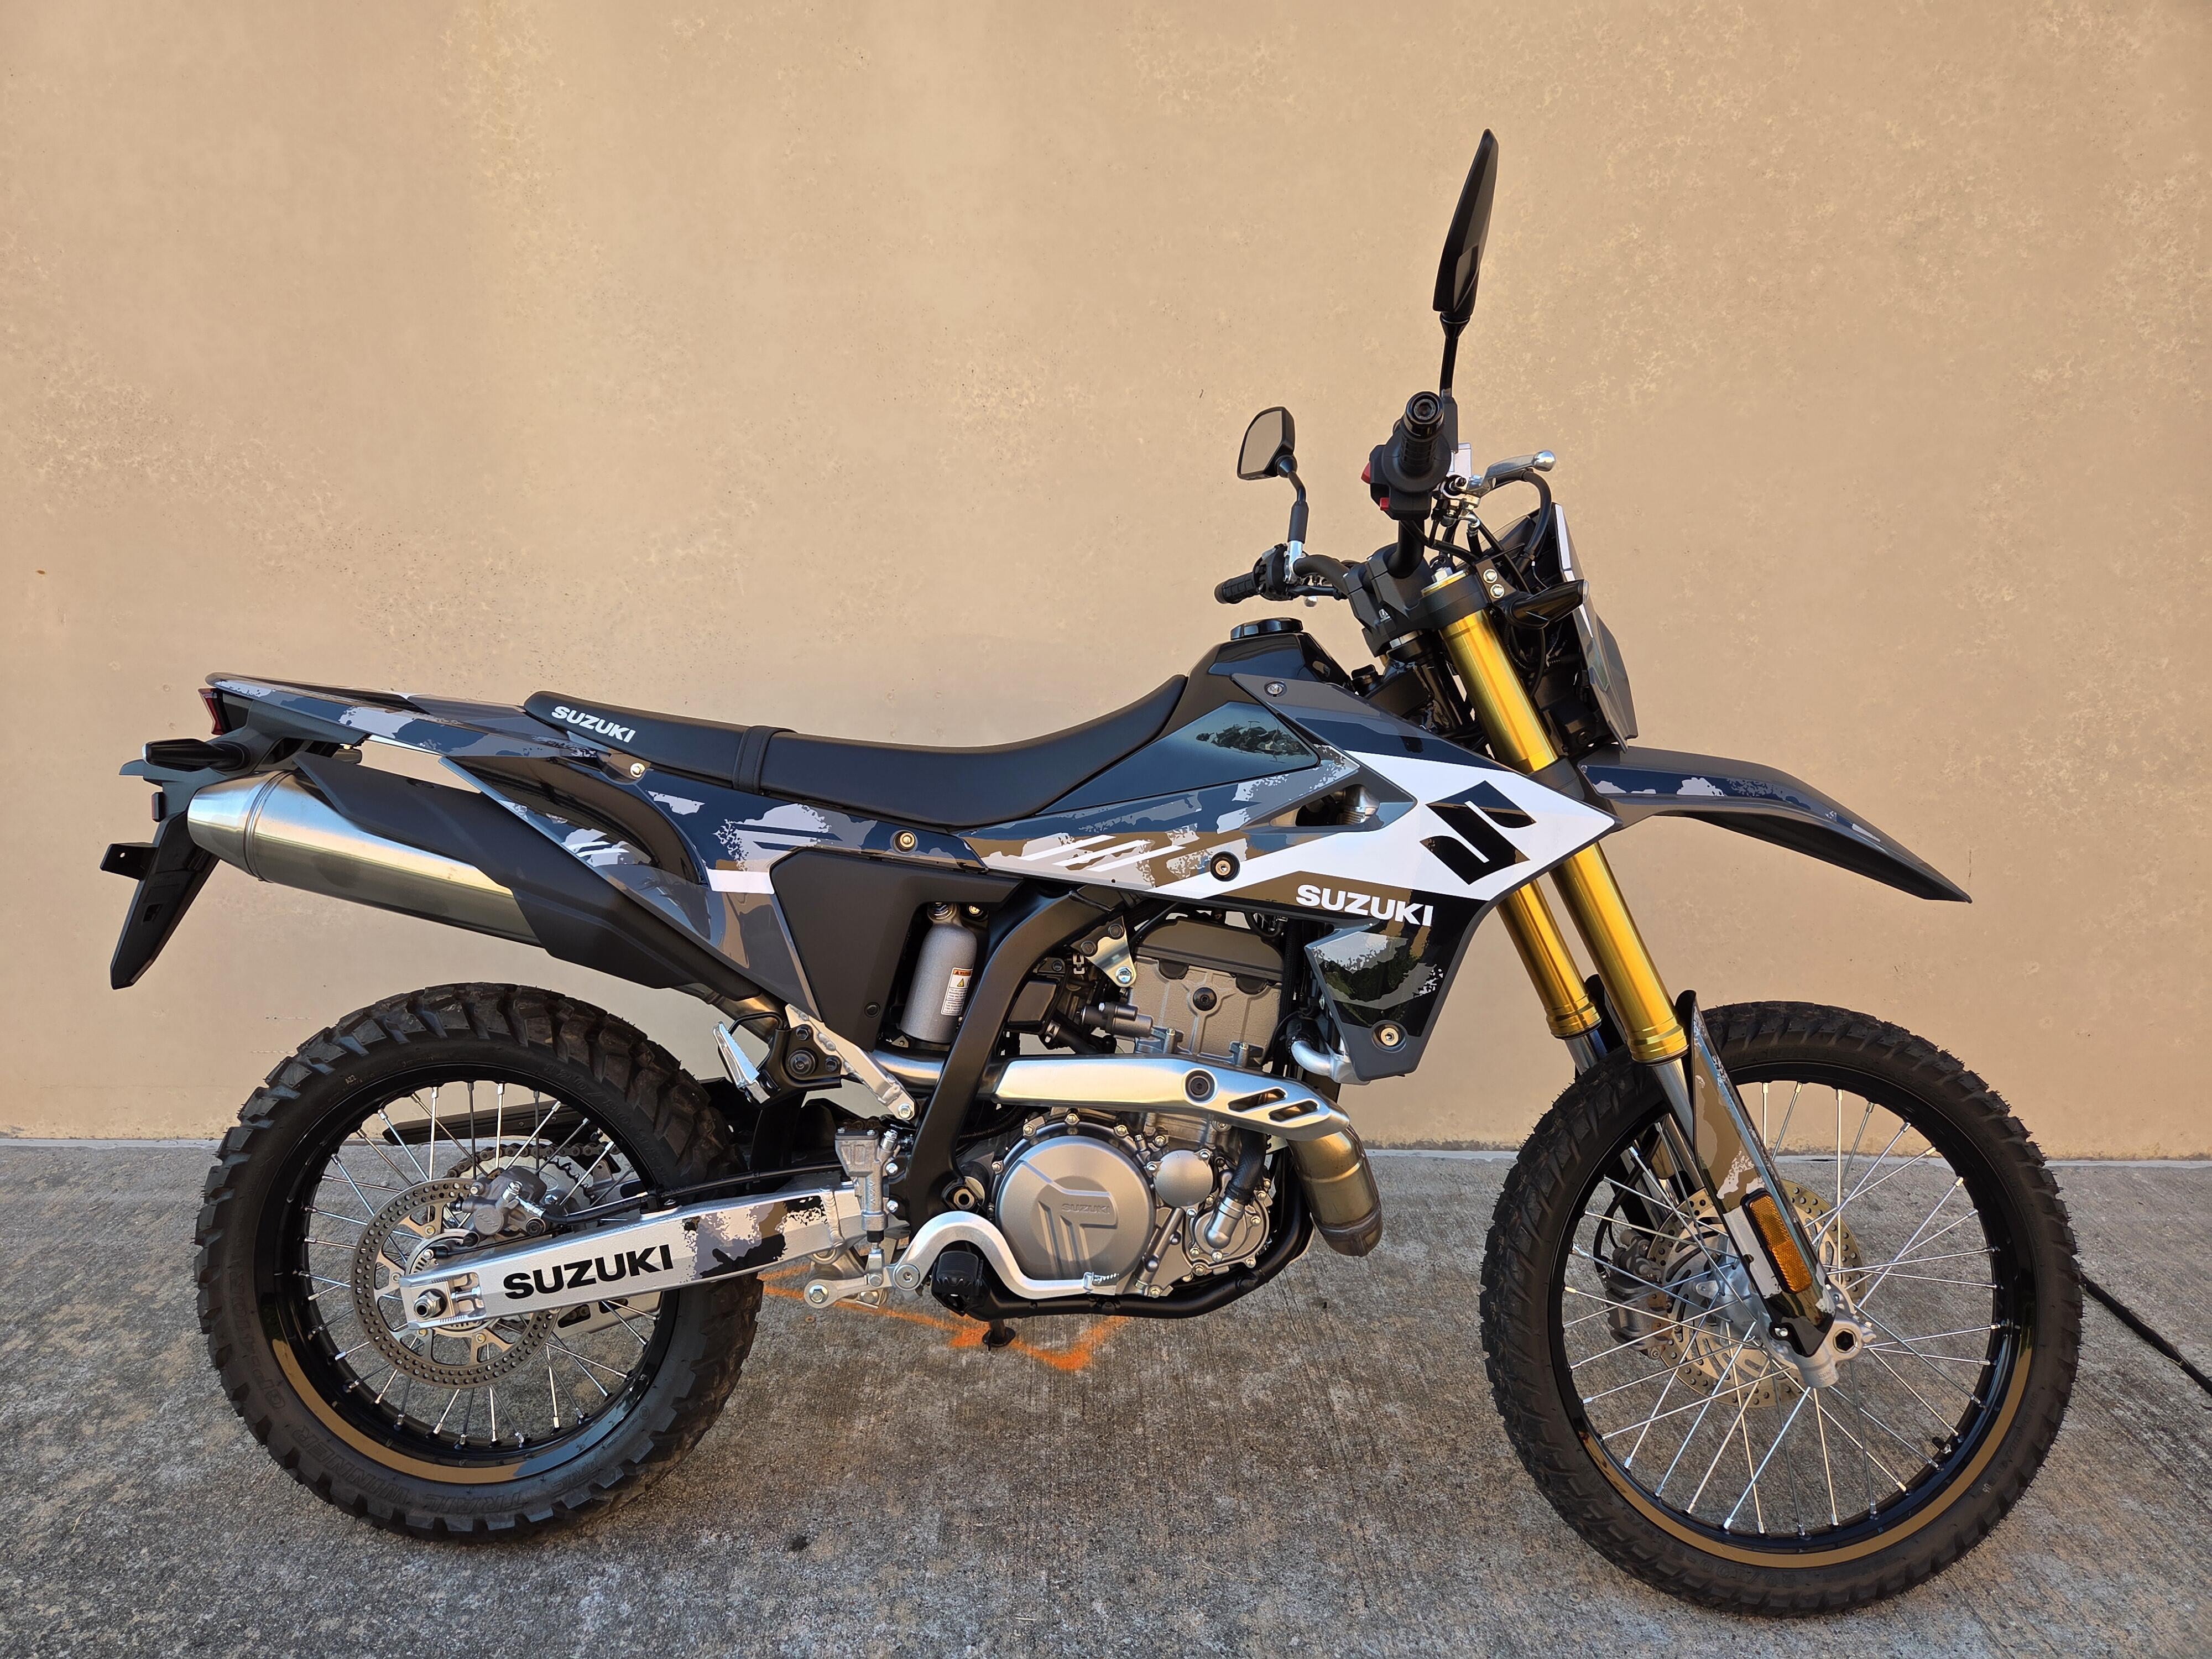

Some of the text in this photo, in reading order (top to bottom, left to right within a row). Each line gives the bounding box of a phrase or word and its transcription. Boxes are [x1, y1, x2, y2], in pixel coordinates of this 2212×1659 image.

[551, 706, 636, 743] SUZUKI
[1296, 884, 1434, 927] SUZUKI
[1061, 1203, 1110, 1214] SUZUKI
[503, 1244, 674, 1300] SUZUKI
[292, 1425, 528, 1514] TRAIL WINNER
